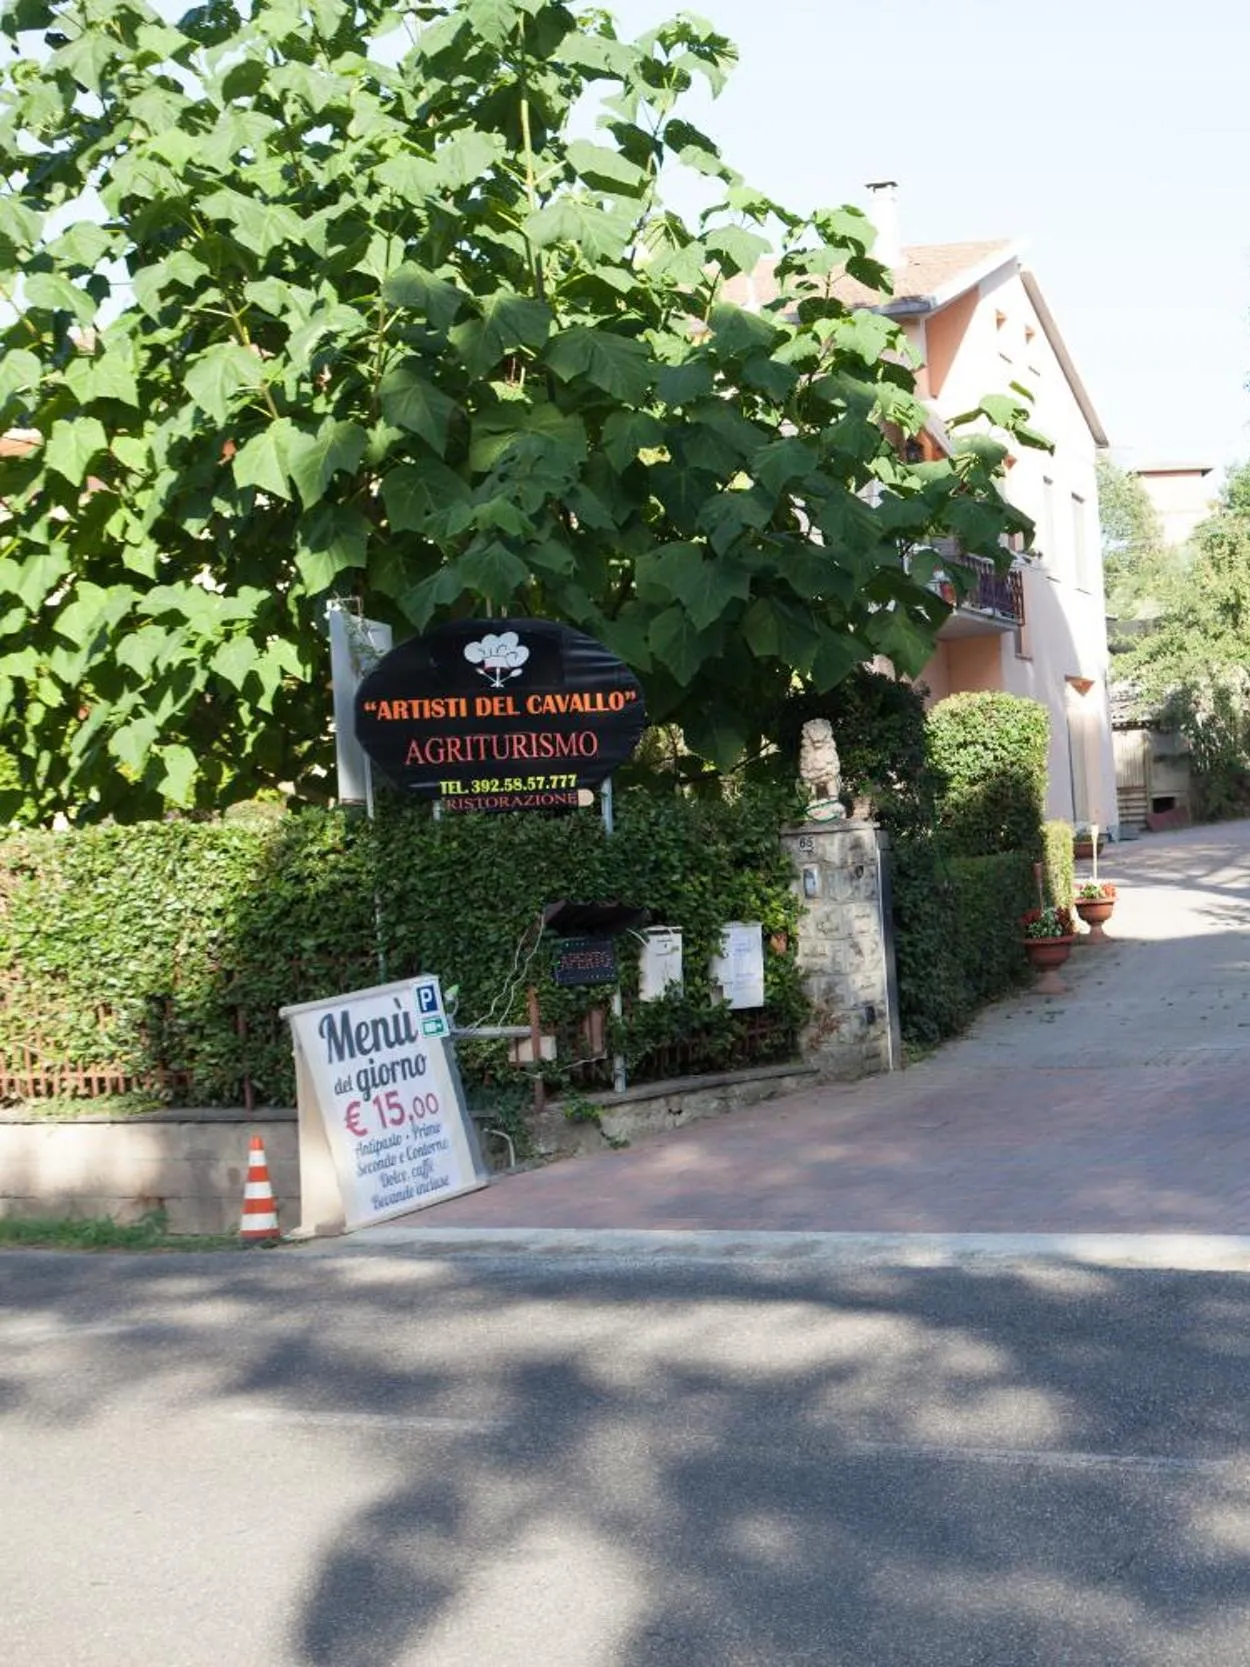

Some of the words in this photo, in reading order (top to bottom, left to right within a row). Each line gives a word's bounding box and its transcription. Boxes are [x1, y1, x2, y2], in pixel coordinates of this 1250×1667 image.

[475, 696, 521, 717] DEL
[405, 731, 598, 765] AGRITURISMO
[440, 781, 468, 795] TEL.
[471, 774, 577, 793] 392.58.57.777
[446, 793, 578, 810] RISTORAZIONE
[318, 997, 419, 1064] Menù
[334, 1074, 354, 1095] del
[356, 1053, 427, 1102] giorno
[344, 1100, 368, 1137] €
[355, 1134, 402, 1159] Antipasto
[412, 1122, 442, 1140] Primo
[357, 1154, 397, 1177] Secondo
[406, 1138, 450, 1161] Contorno
